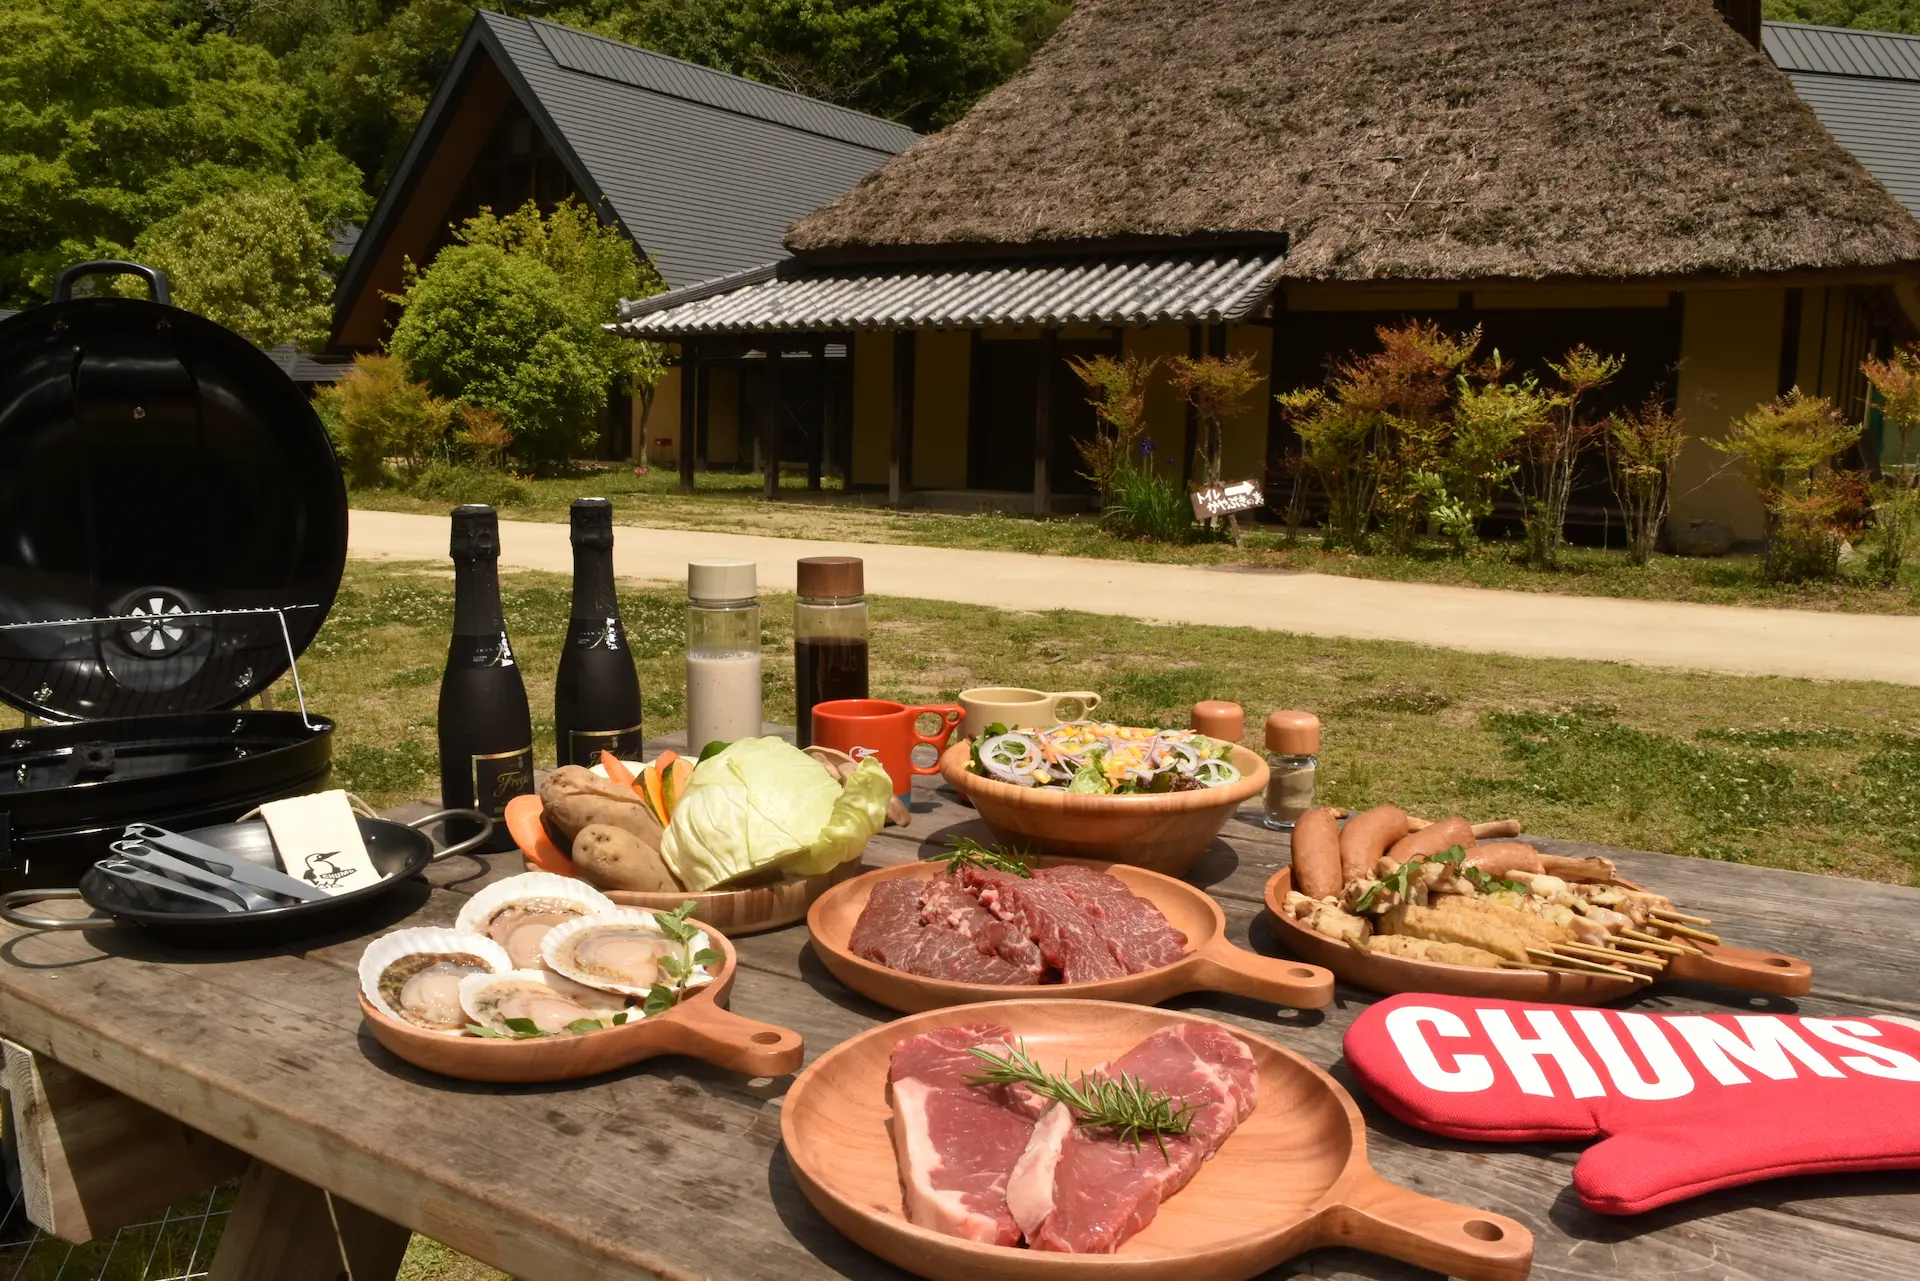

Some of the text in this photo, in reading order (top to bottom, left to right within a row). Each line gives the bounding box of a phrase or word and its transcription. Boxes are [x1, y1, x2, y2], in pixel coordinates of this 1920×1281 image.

[1197, 489, 1221, 505] トイレ
[321, 868, 356, 879] CHUMS
[1384, 1005, 1920, 1100] CHUMS
